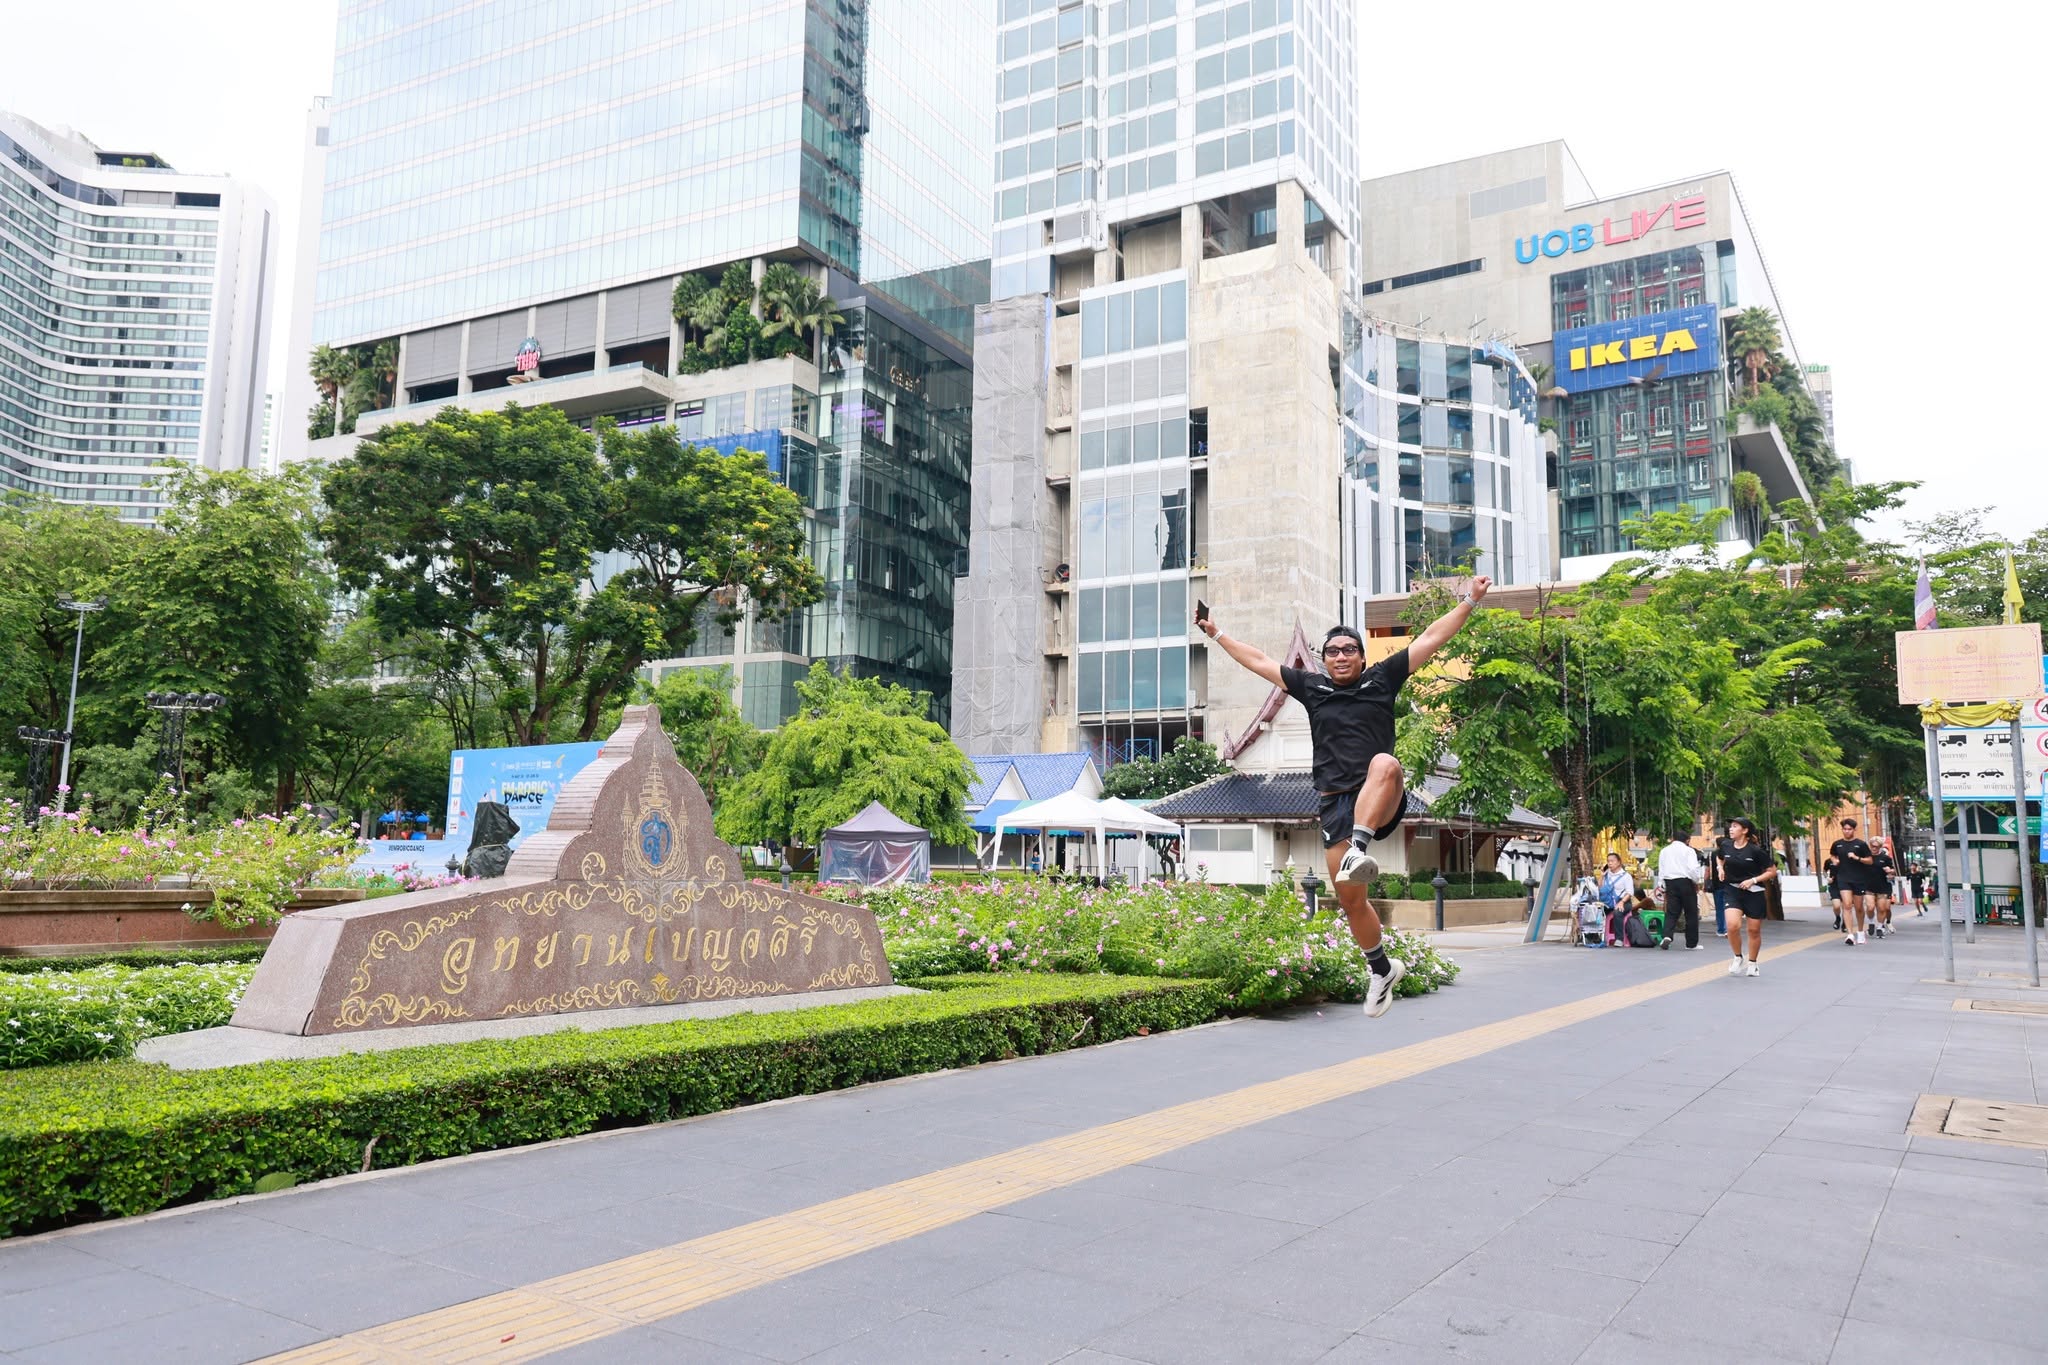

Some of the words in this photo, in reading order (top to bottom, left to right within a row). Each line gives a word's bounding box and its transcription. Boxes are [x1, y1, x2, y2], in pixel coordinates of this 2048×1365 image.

[1515, 223, 1595, 264] UOB
[1603, 196, 1706, 246] LIVE
[1570, 329, 1698, 371] IKEA
[504, 792, 544, 805] DANCE
[440, 915, 819, 995] อุทยานเบญจสิริ
